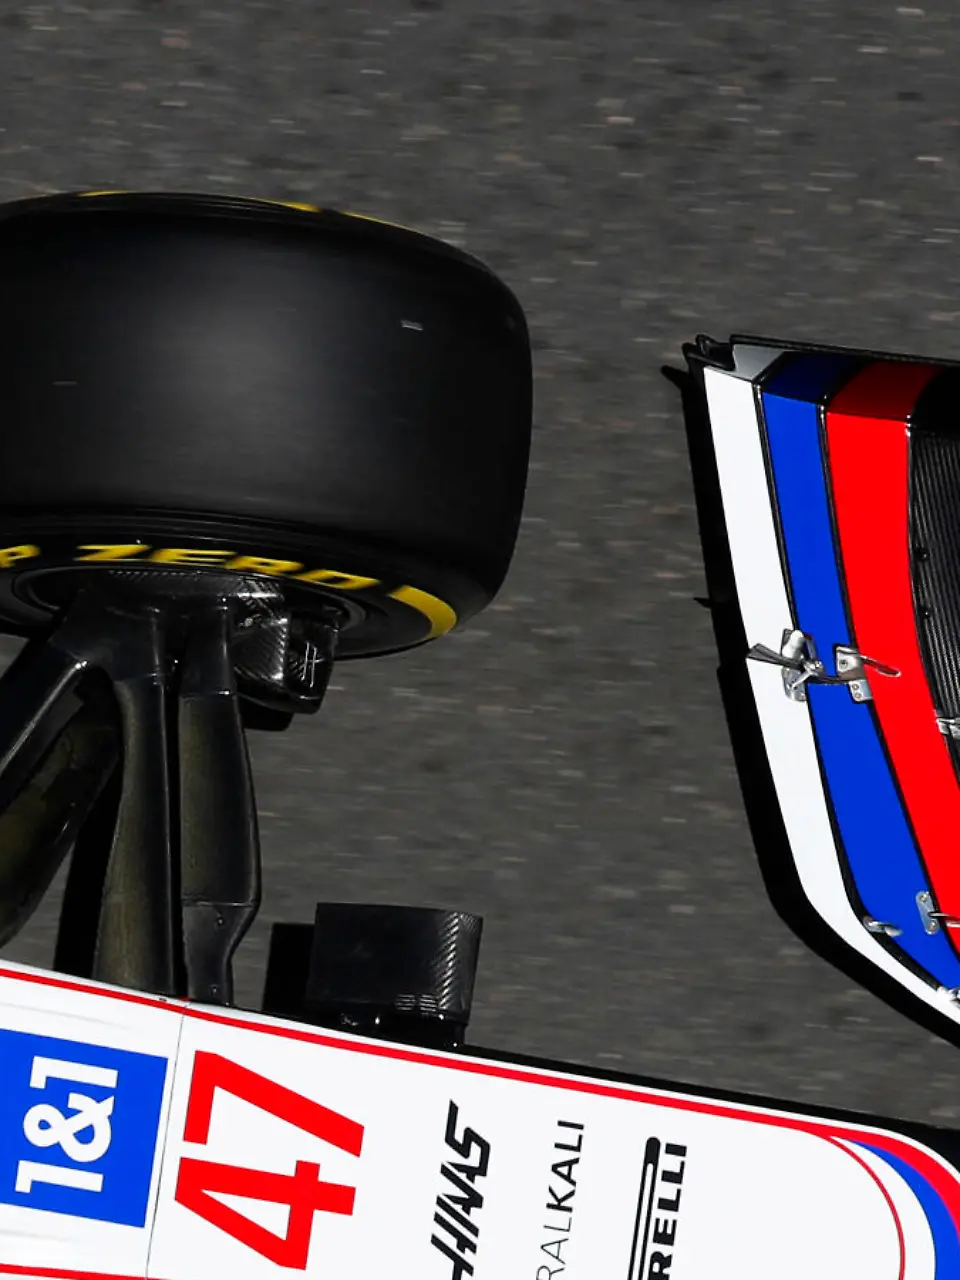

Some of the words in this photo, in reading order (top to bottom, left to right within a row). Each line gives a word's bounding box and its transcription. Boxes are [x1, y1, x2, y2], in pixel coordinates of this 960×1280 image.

[76, 544, 380, 590] ZERO
[15, 1056, 117, 1193] 1&1
[175, 1050, 365, 1270] 47
